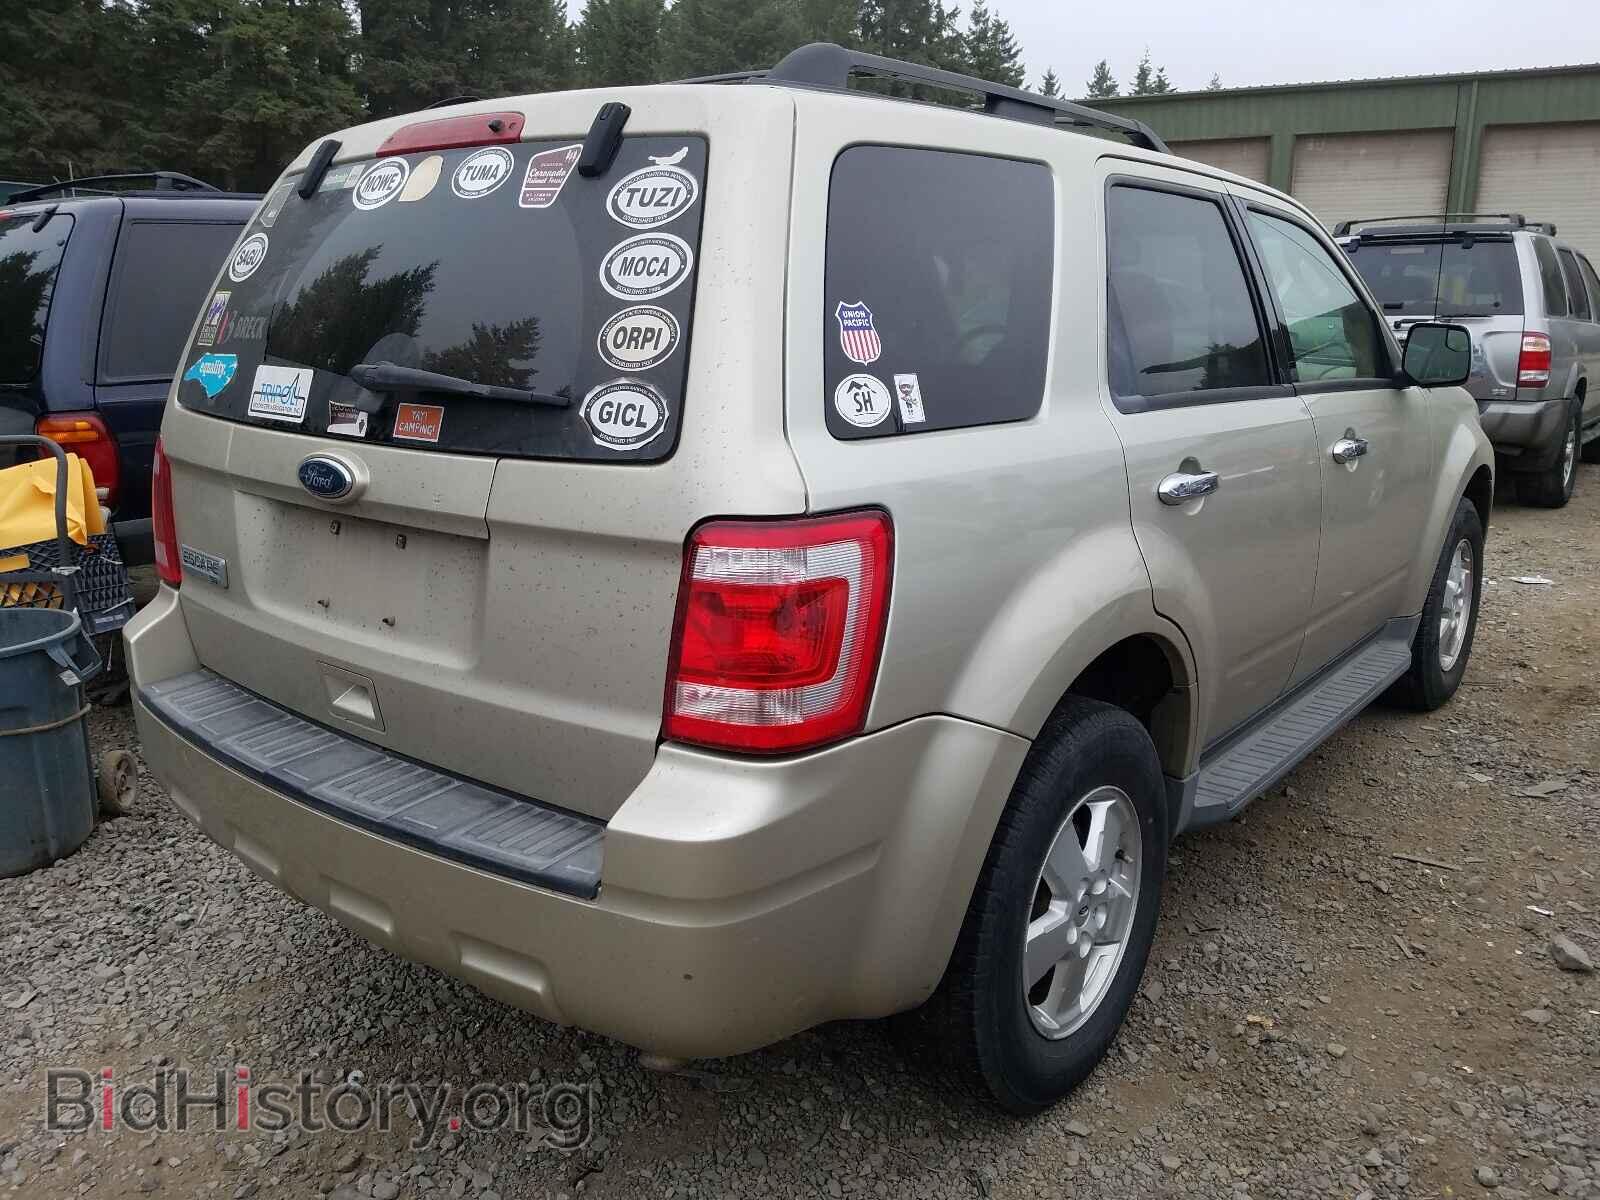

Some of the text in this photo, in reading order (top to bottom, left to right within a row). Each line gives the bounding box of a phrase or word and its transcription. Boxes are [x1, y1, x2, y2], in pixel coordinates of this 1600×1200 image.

[361, 172, 400, 192] MOWE
[463, 164, 500, 181] TUMA
[529, 168, 566, 177] Coronado
[625, 186, 682, 207] TUZI
[618, 256, 670, 277] MOCA
[842, 310, 866, 318] UNION
[843, 319, 870, 327] PACIFIC
[612, 326, 663, 350] ORPI
[853, 391, 874, 412] SH
[598, 400, 648, 428] GICL
[399, 422, 436, 435] CAMPING!
[304, 464, 334, 488] Ford
[182, 550, 221, 574] ESCAPE
